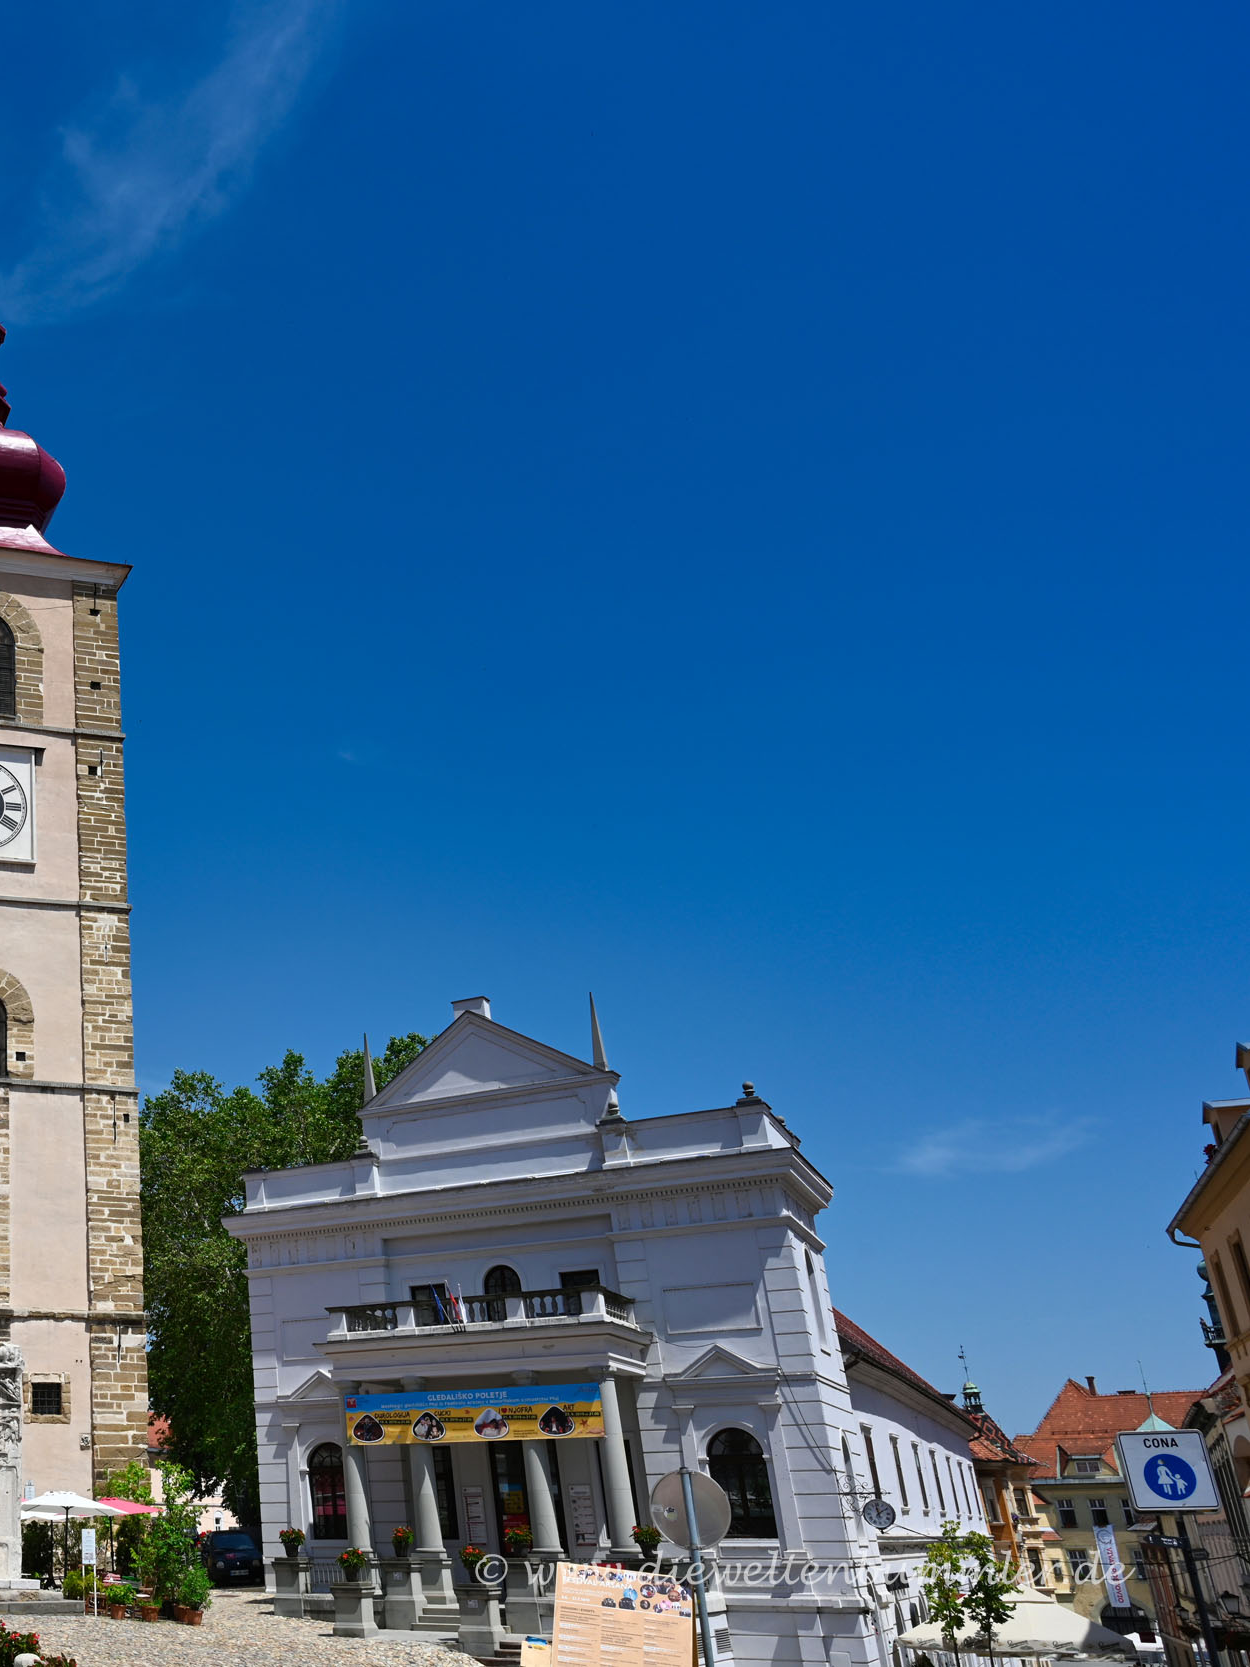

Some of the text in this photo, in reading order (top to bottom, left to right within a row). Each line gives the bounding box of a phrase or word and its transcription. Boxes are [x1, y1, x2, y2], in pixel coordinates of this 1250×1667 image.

[427, 1390, 507, 1401] GLEDALIŠKO POLETJE
[1143, 1437, 1179, 1449] CONA
[599, 1580, 633, 1590] ARSANA
